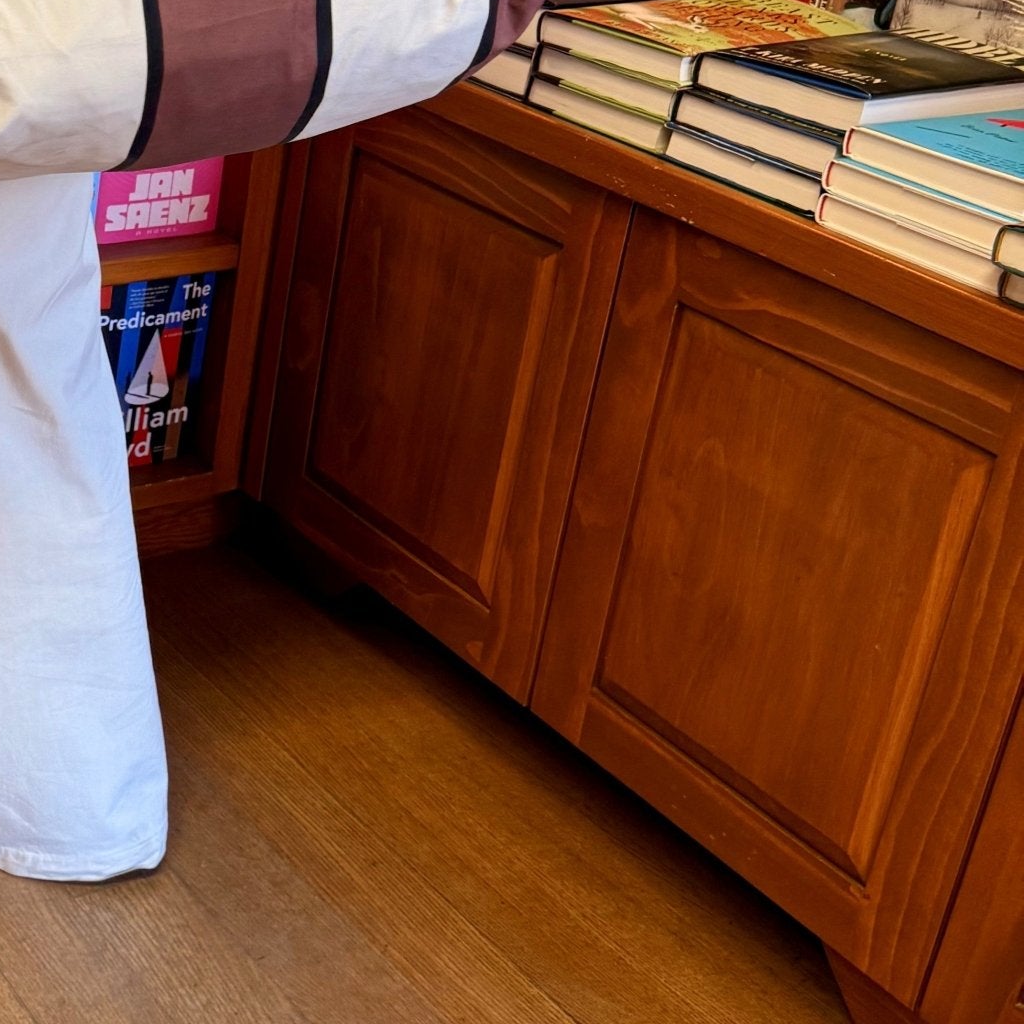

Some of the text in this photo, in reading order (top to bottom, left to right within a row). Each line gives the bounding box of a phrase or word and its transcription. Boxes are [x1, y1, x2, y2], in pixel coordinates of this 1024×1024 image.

[129, 168, 195, 202] JAN
[104, 194, 211, 232] SAENZ
[182, 282, 212, 301] The
[99, 302, 209, 332] Predicament
